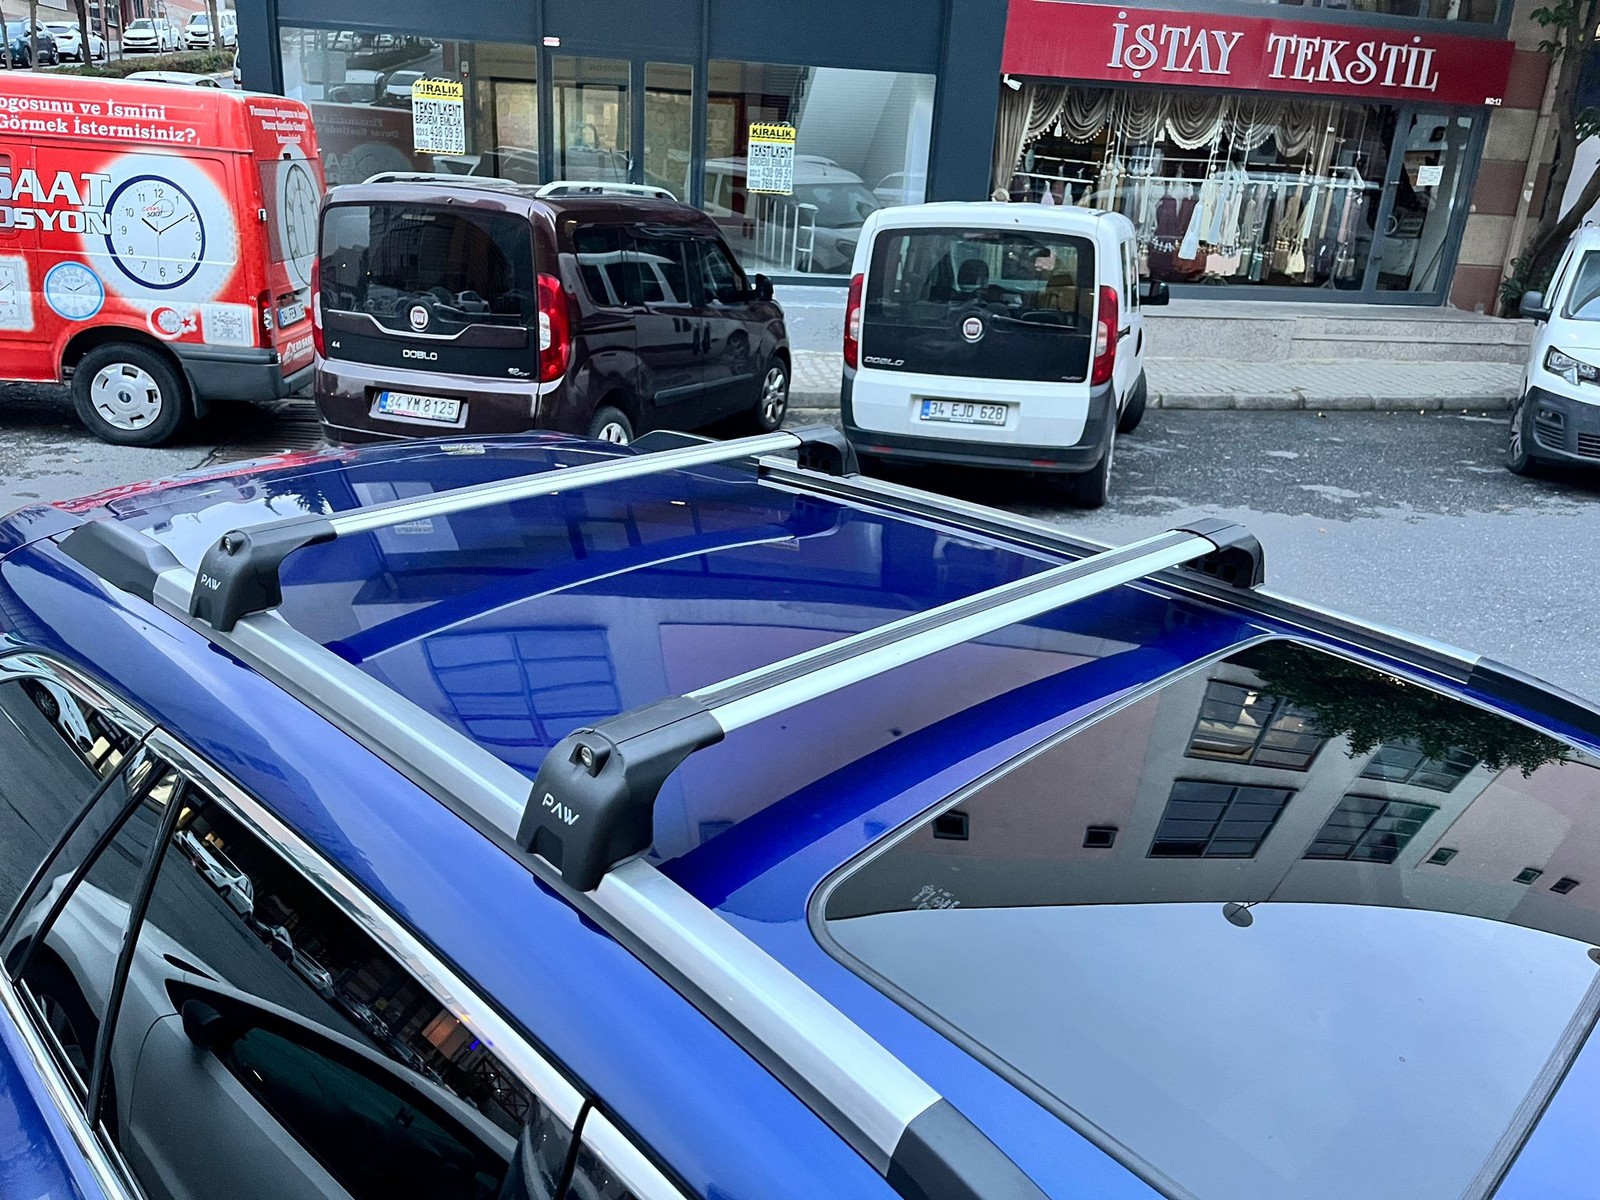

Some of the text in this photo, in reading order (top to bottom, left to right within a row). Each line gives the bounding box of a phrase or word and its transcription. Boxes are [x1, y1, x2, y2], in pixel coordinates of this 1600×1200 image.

[1267, 33, 1439, 92] TEKSTİL
[414, 83, 460, 95] KIRALIK
[79, 103, 101, 115] ve
[106, 98, 166, 120] İsmini
[415, 115, 462, 127] ERDEM EMLAK
[0, 114, 196, 142] Görmek İstermisiniz?
[455, 128, 463, 139] 51
[752, 128, 792, 137] KIRALIK
[138, 193, 146, 203] 11
[154, 188, 164, 198] 12
[125, 207, 134, 218] 10
[402, 349, 438, 361] DOBLO
[864, 356, 905, 366] DOBLO
[388, 395, 402, 409] 34
[407, 397, 420, 411] YM
[424, 399, 456, 415] 8125
[930, 402, 1004, 420] 34 EJD 628
[200, 573, 221, 591] PAW
[541, 792, 580, 826] PAW
